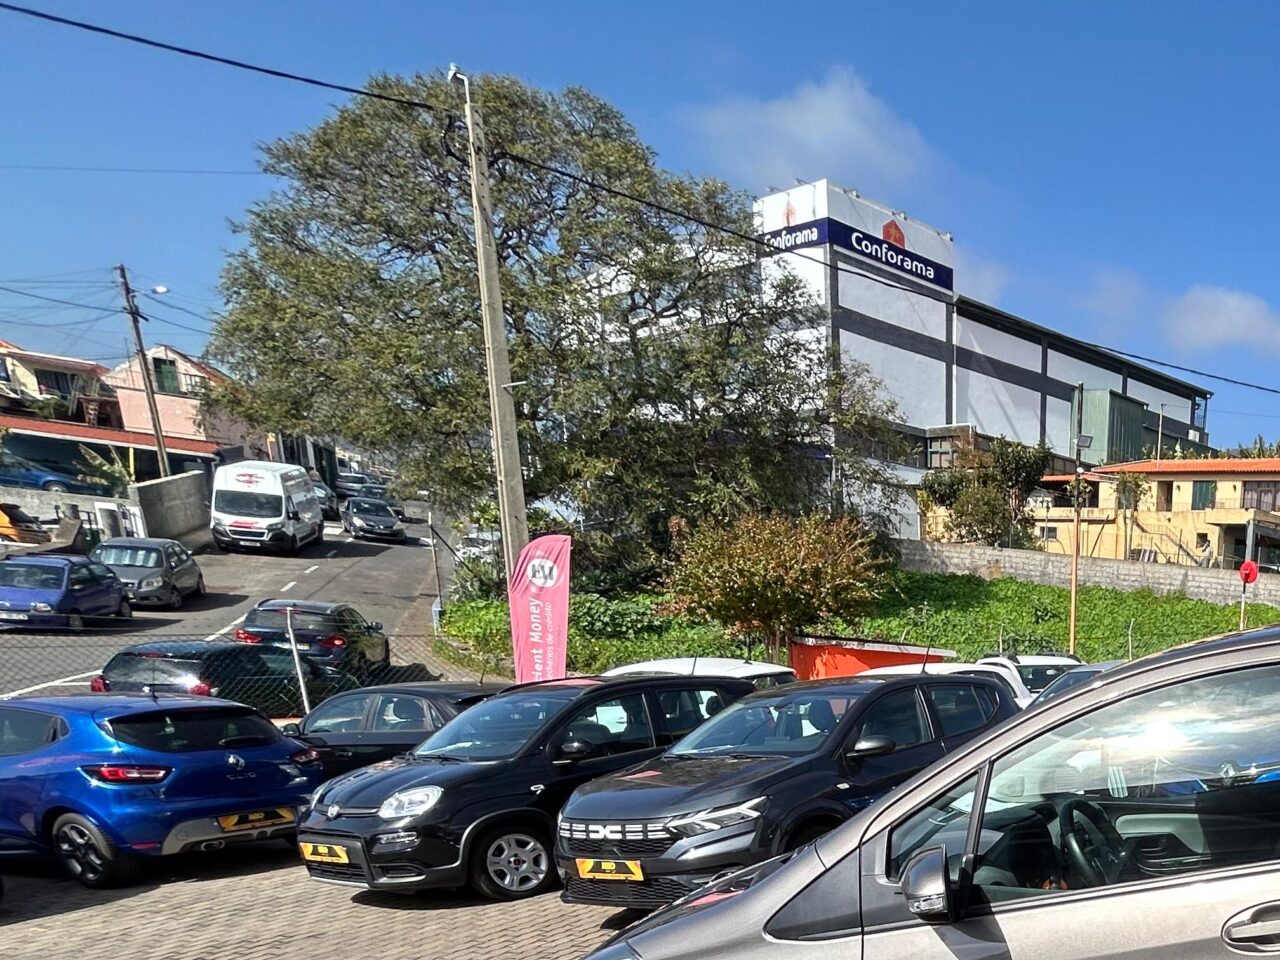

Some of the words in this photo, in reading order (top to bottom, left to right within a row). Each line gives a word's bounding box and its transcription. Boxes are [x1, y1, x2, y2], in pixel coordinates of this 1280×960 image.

[764, 227, 818, 252] Conforama
[851, 231, 935, 280] Conforama
[528, 597, 544, 642] Money
